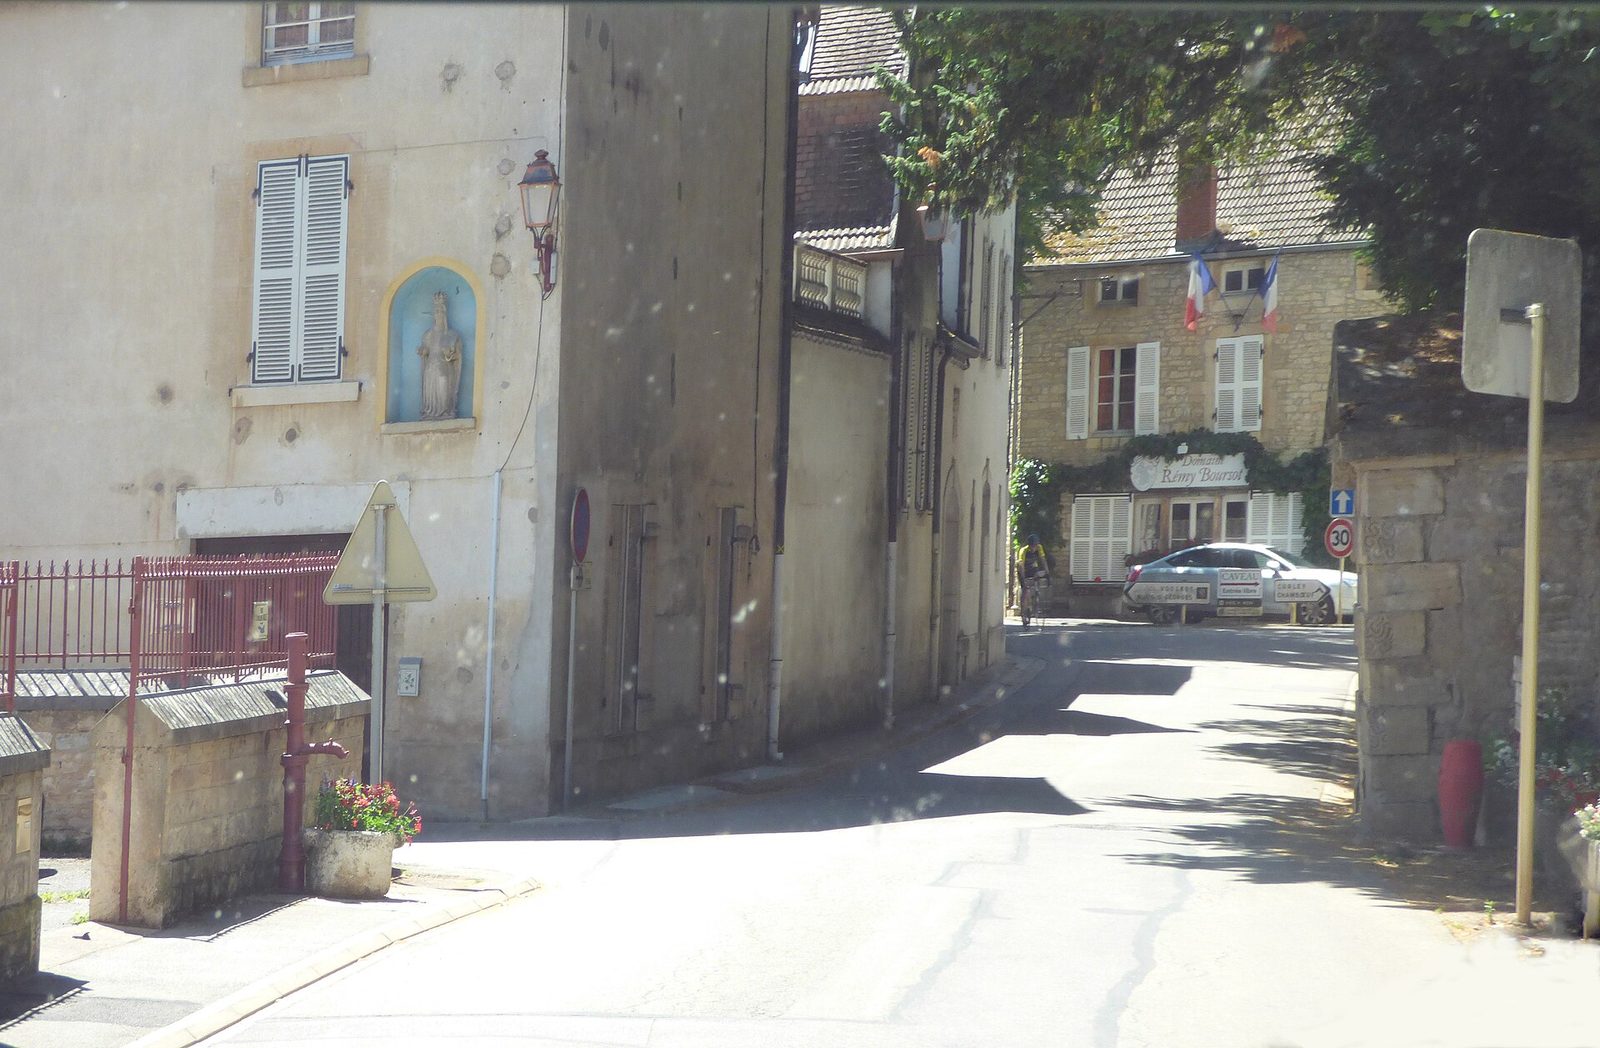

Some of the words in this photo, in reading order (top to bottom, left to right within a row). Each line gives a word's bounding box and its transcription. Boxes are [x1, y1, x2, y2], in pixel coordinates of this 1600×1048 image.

[1161, 469, 1196, 487] Rémy
[1200, 467, 1242, 482] Boursot
[1332, 530, 1349, 546] 30
[1221, 572, 1259, 580] CAVEAU
